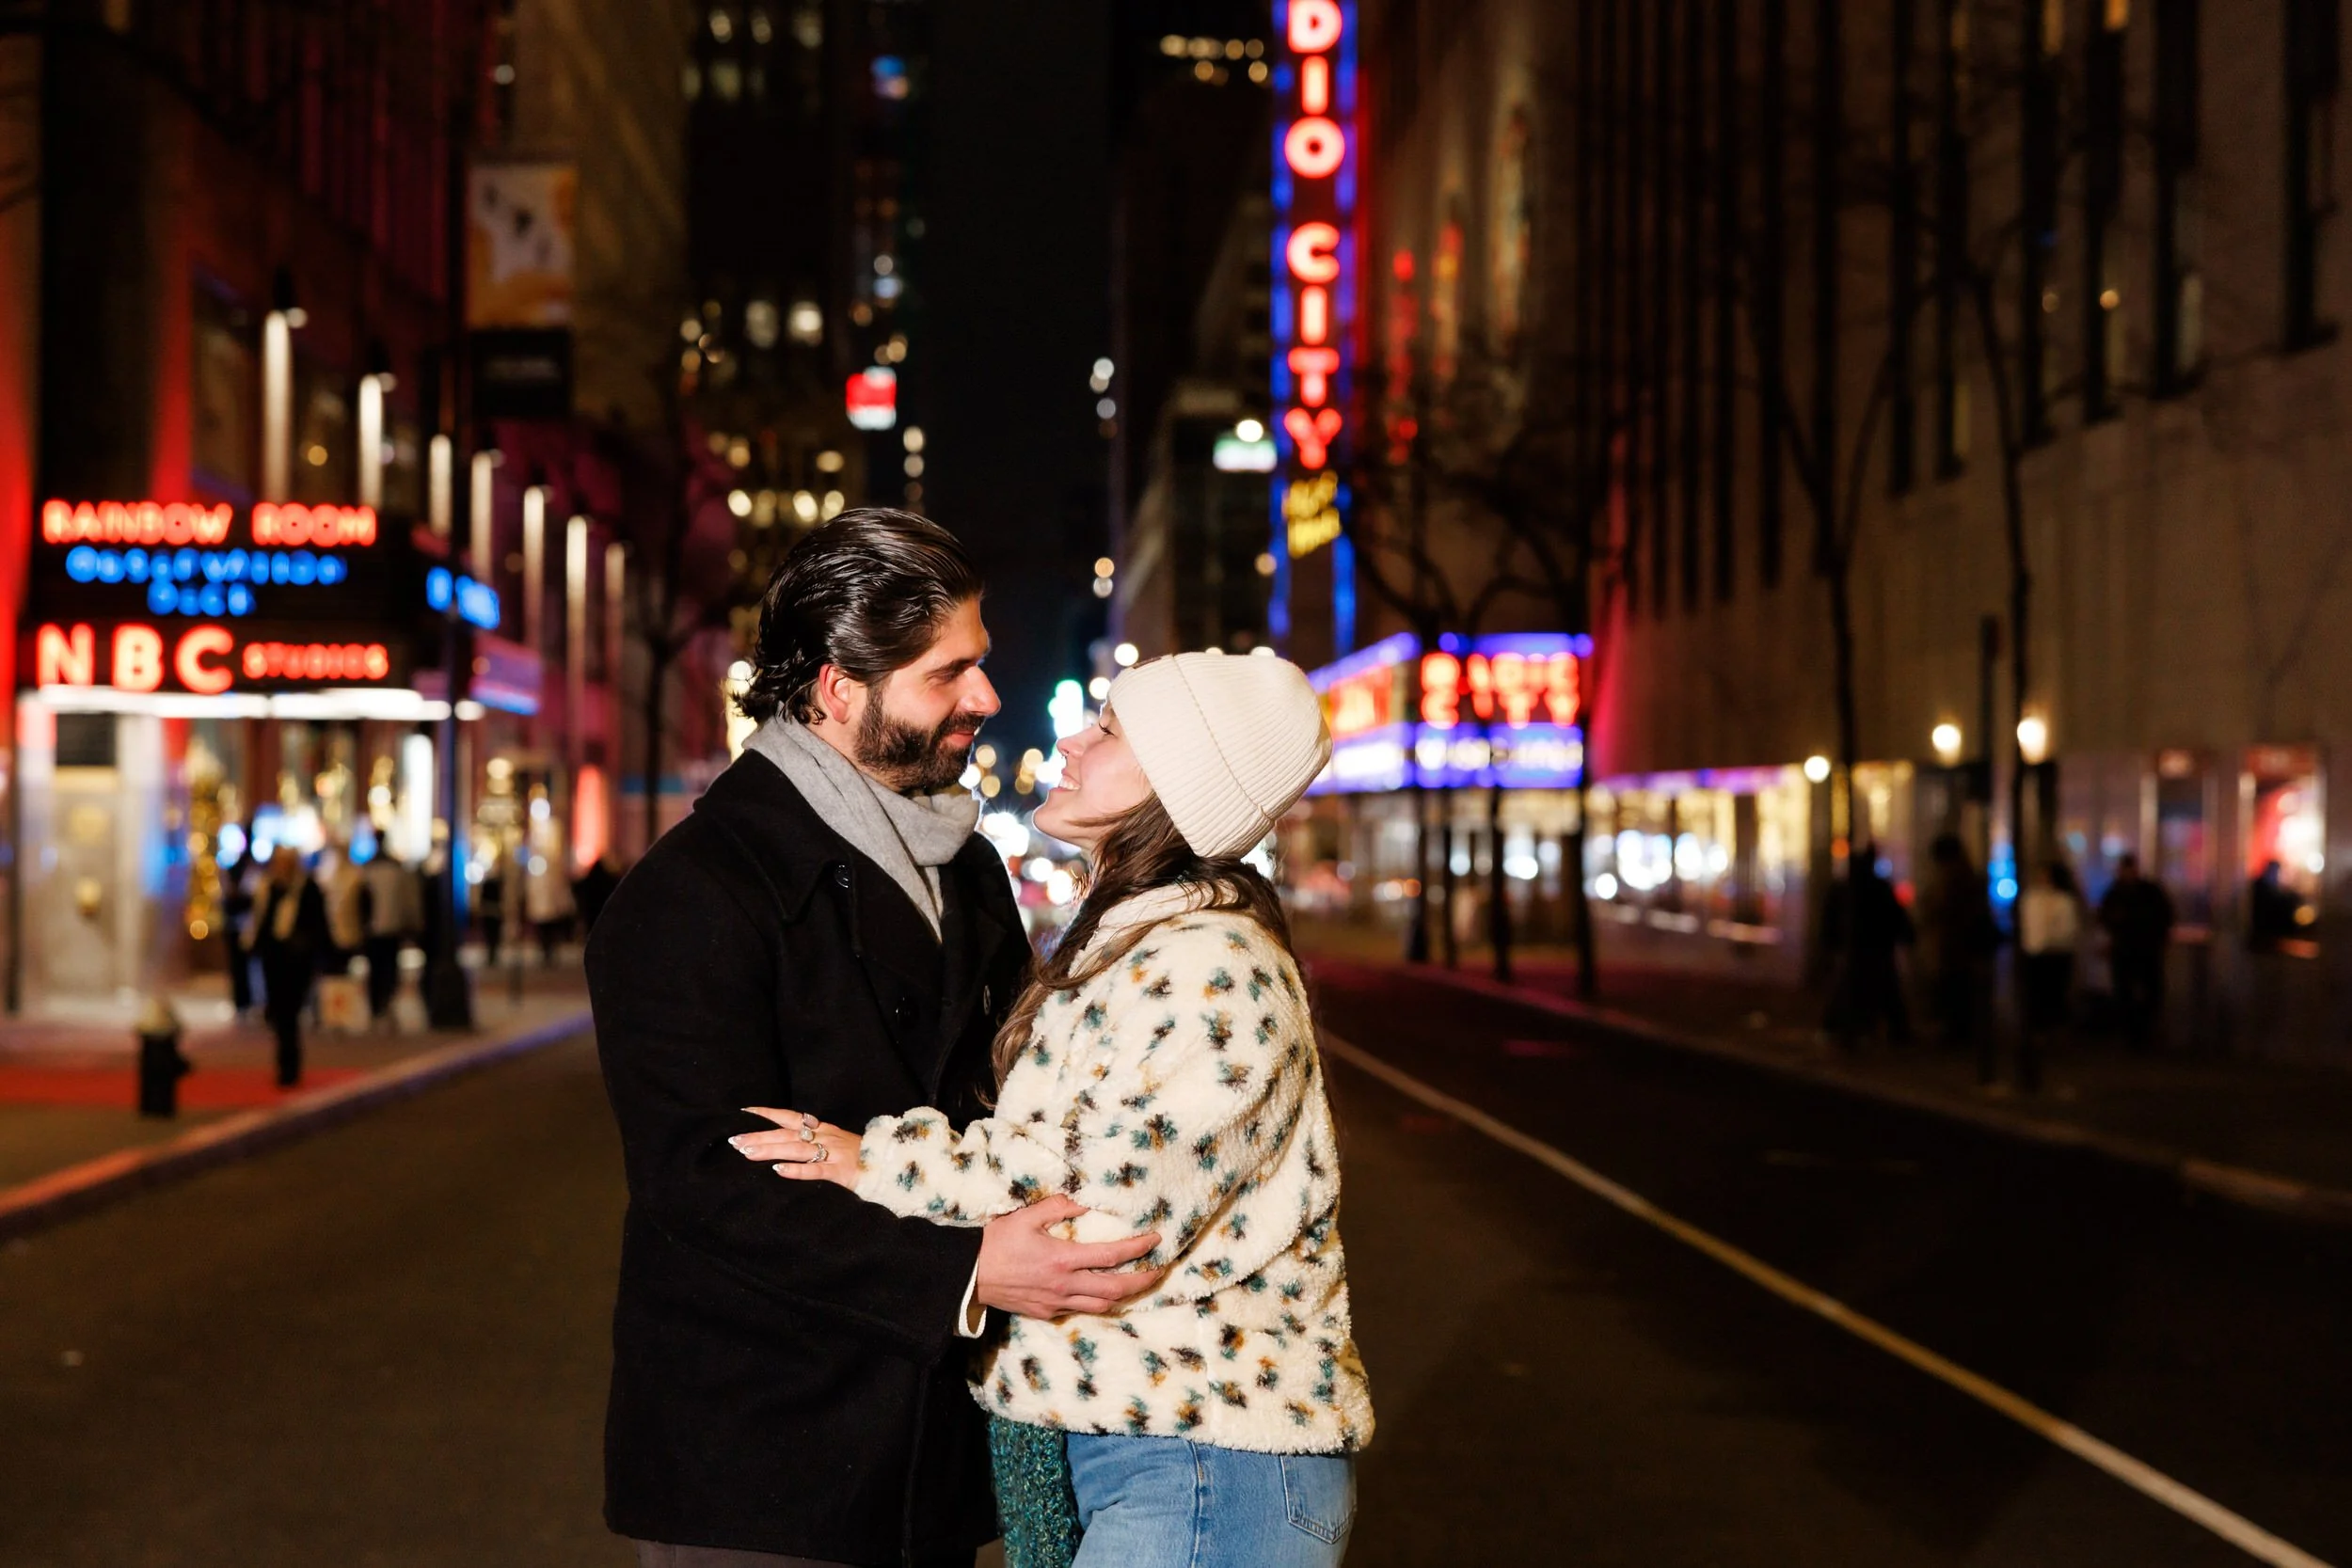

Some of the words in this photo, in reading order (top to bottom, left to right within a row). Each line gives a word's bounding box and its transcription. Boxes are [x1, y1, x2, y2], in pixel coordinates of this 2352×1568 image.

[1283, 221, 1343, 468] CITY
[42, 499, 233, 545] RAINBOW
[251, 502, 376, 546] ROOM
[37, 623, 233, 693] NBC
